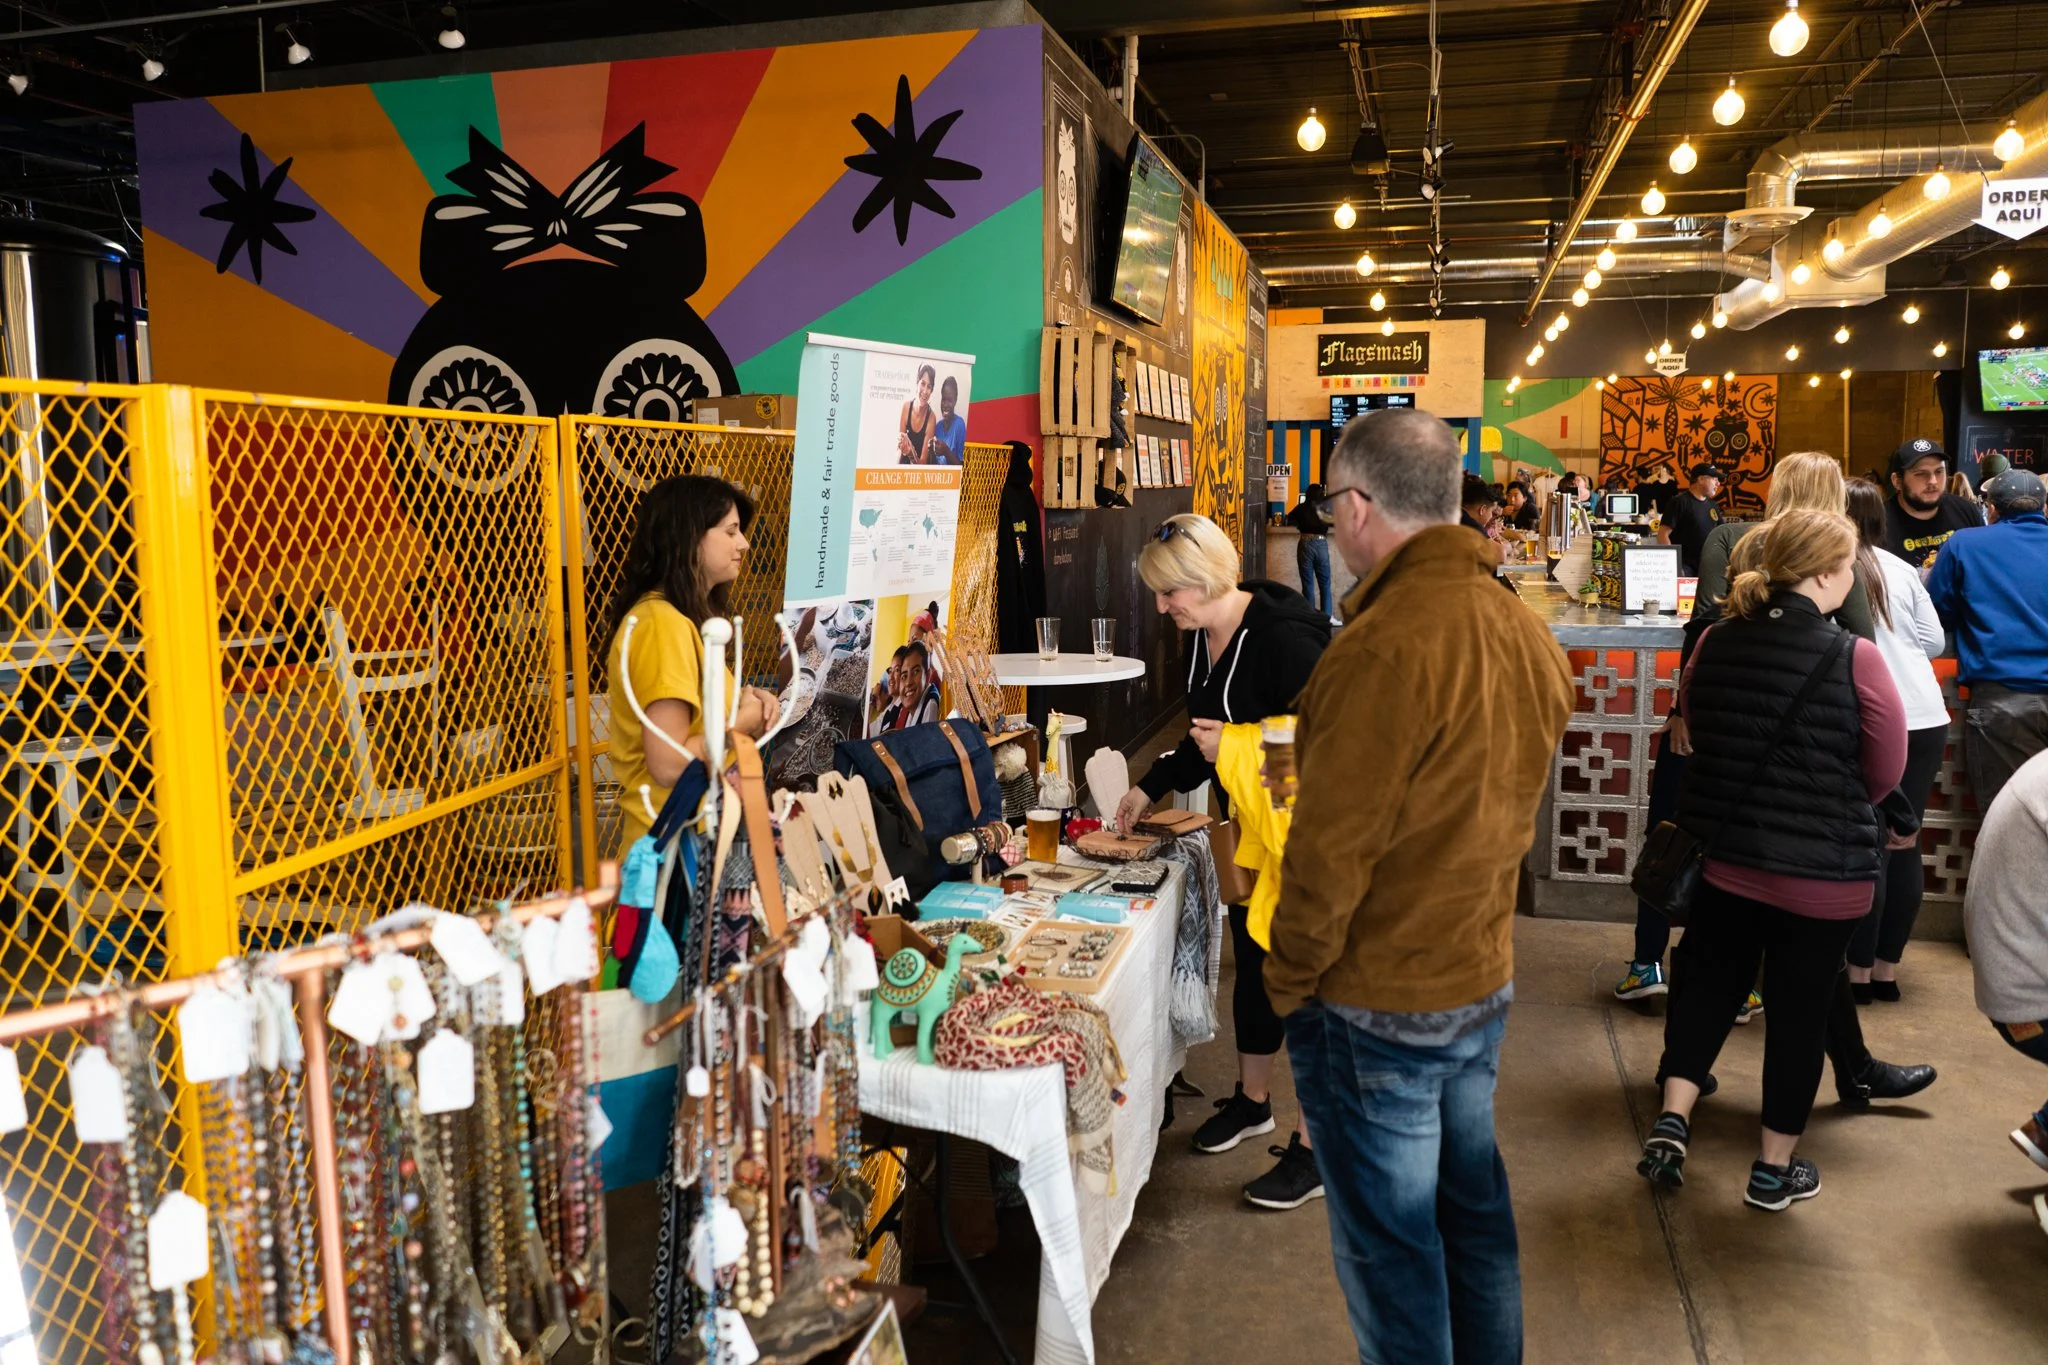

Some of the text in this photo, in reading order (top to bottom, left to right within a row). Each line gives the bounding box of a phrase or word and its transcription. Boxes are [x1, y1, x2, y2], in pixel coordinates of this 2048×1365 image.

[1988, 190, 2048, 204] ORDER
[1996, 202, 2042, 222] AQUÍ
[1320, 340, 1423, 367] Flagsmash
[815, 352, 840, 589] handmade & fair trade goods
[865, 471, 954, 485] CHANGE THE WORLD
[1267, 465, 1291, 476] OPEN
